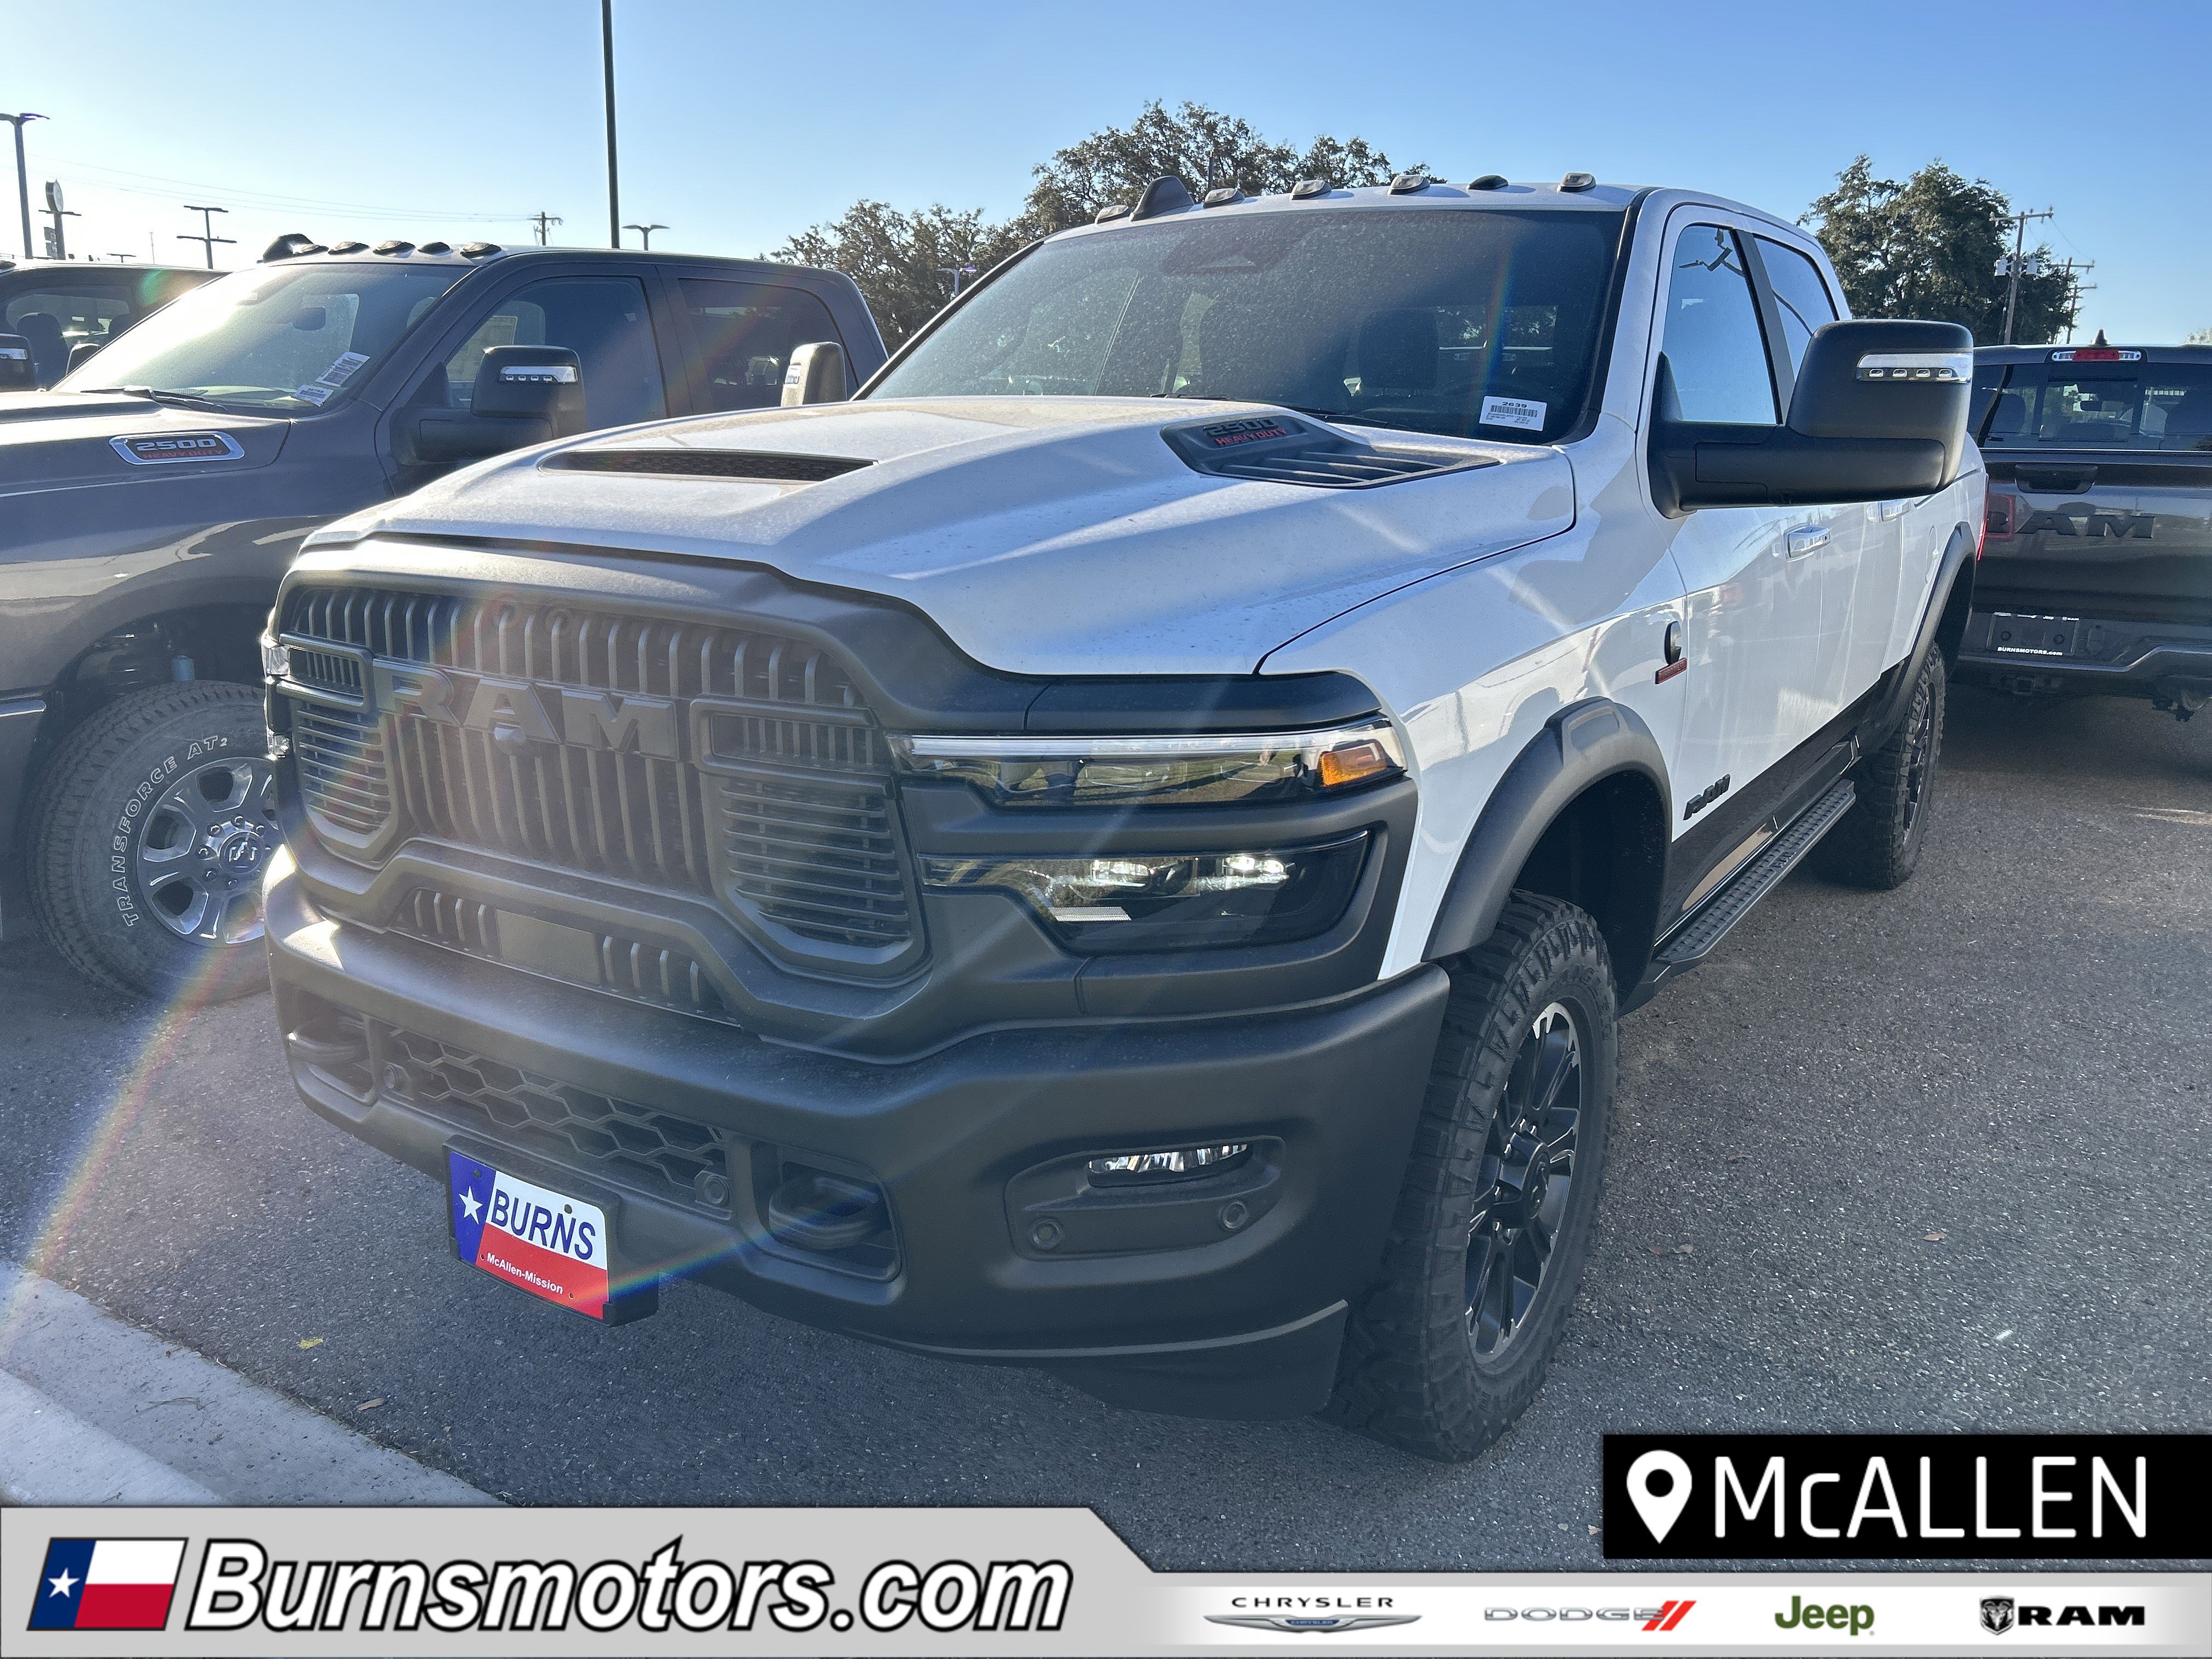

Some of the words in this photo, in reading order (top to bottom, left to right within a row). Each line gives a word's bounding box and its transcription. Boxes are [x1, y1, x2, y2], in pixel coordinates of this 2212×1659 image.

[136, 438, 217, 451] 2500
[1203, 419, 1279, 436] 2500
[1214, 433, 1255, 445] HEAVY
[1255, 428, 1286, 440] DUTY
[373, 658, 680, 762] RAM
[111, 756, 178, 927] TRANSFORCE
[490, 1188, 596, 1261] BURNS
[487, 1252, 563, 1295] McAllen-Mission
